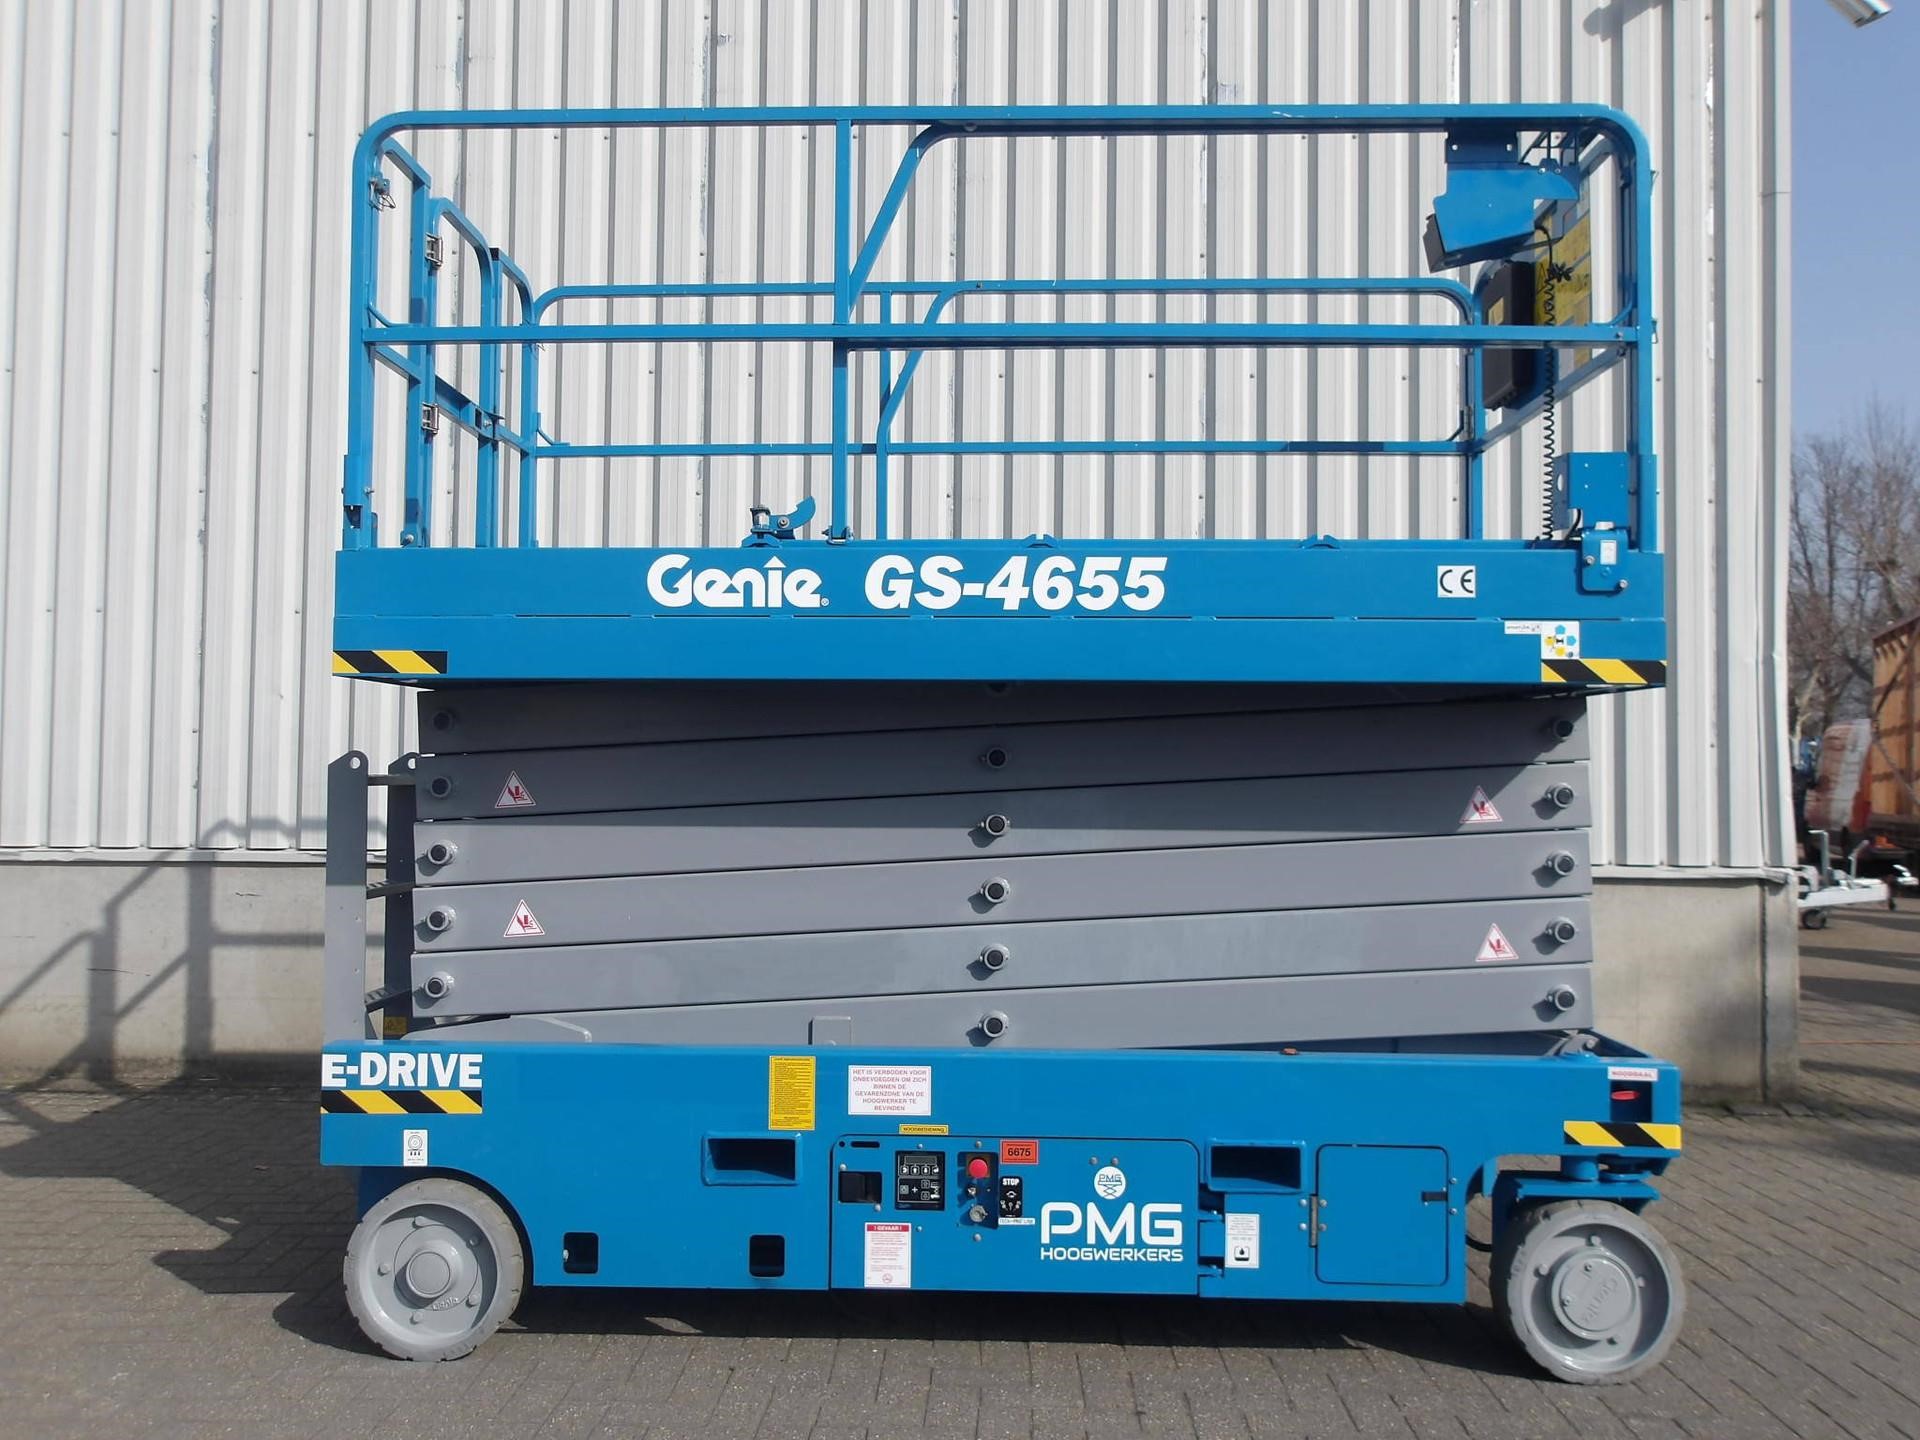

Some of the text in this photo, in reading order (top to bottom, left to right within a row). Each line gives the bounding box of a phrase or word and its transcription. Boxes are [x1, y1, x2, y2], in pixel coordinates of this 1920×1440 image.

[647, 554, 1168, 611] Genie GS-4655
[1440, 569, 1474, 594] CE
[321, 1052, 483, 1088] E-DRIVE
[1007, 1147, 1032, 1157] 6675
[1002, 1178, 1020, 1186] STOP
[1098, 1174, 1122, 1182] PMG
[1040, 1201, 1183, 1246] PMG
[1041, 1247, 1184, 1263] HOOGWERKERS
